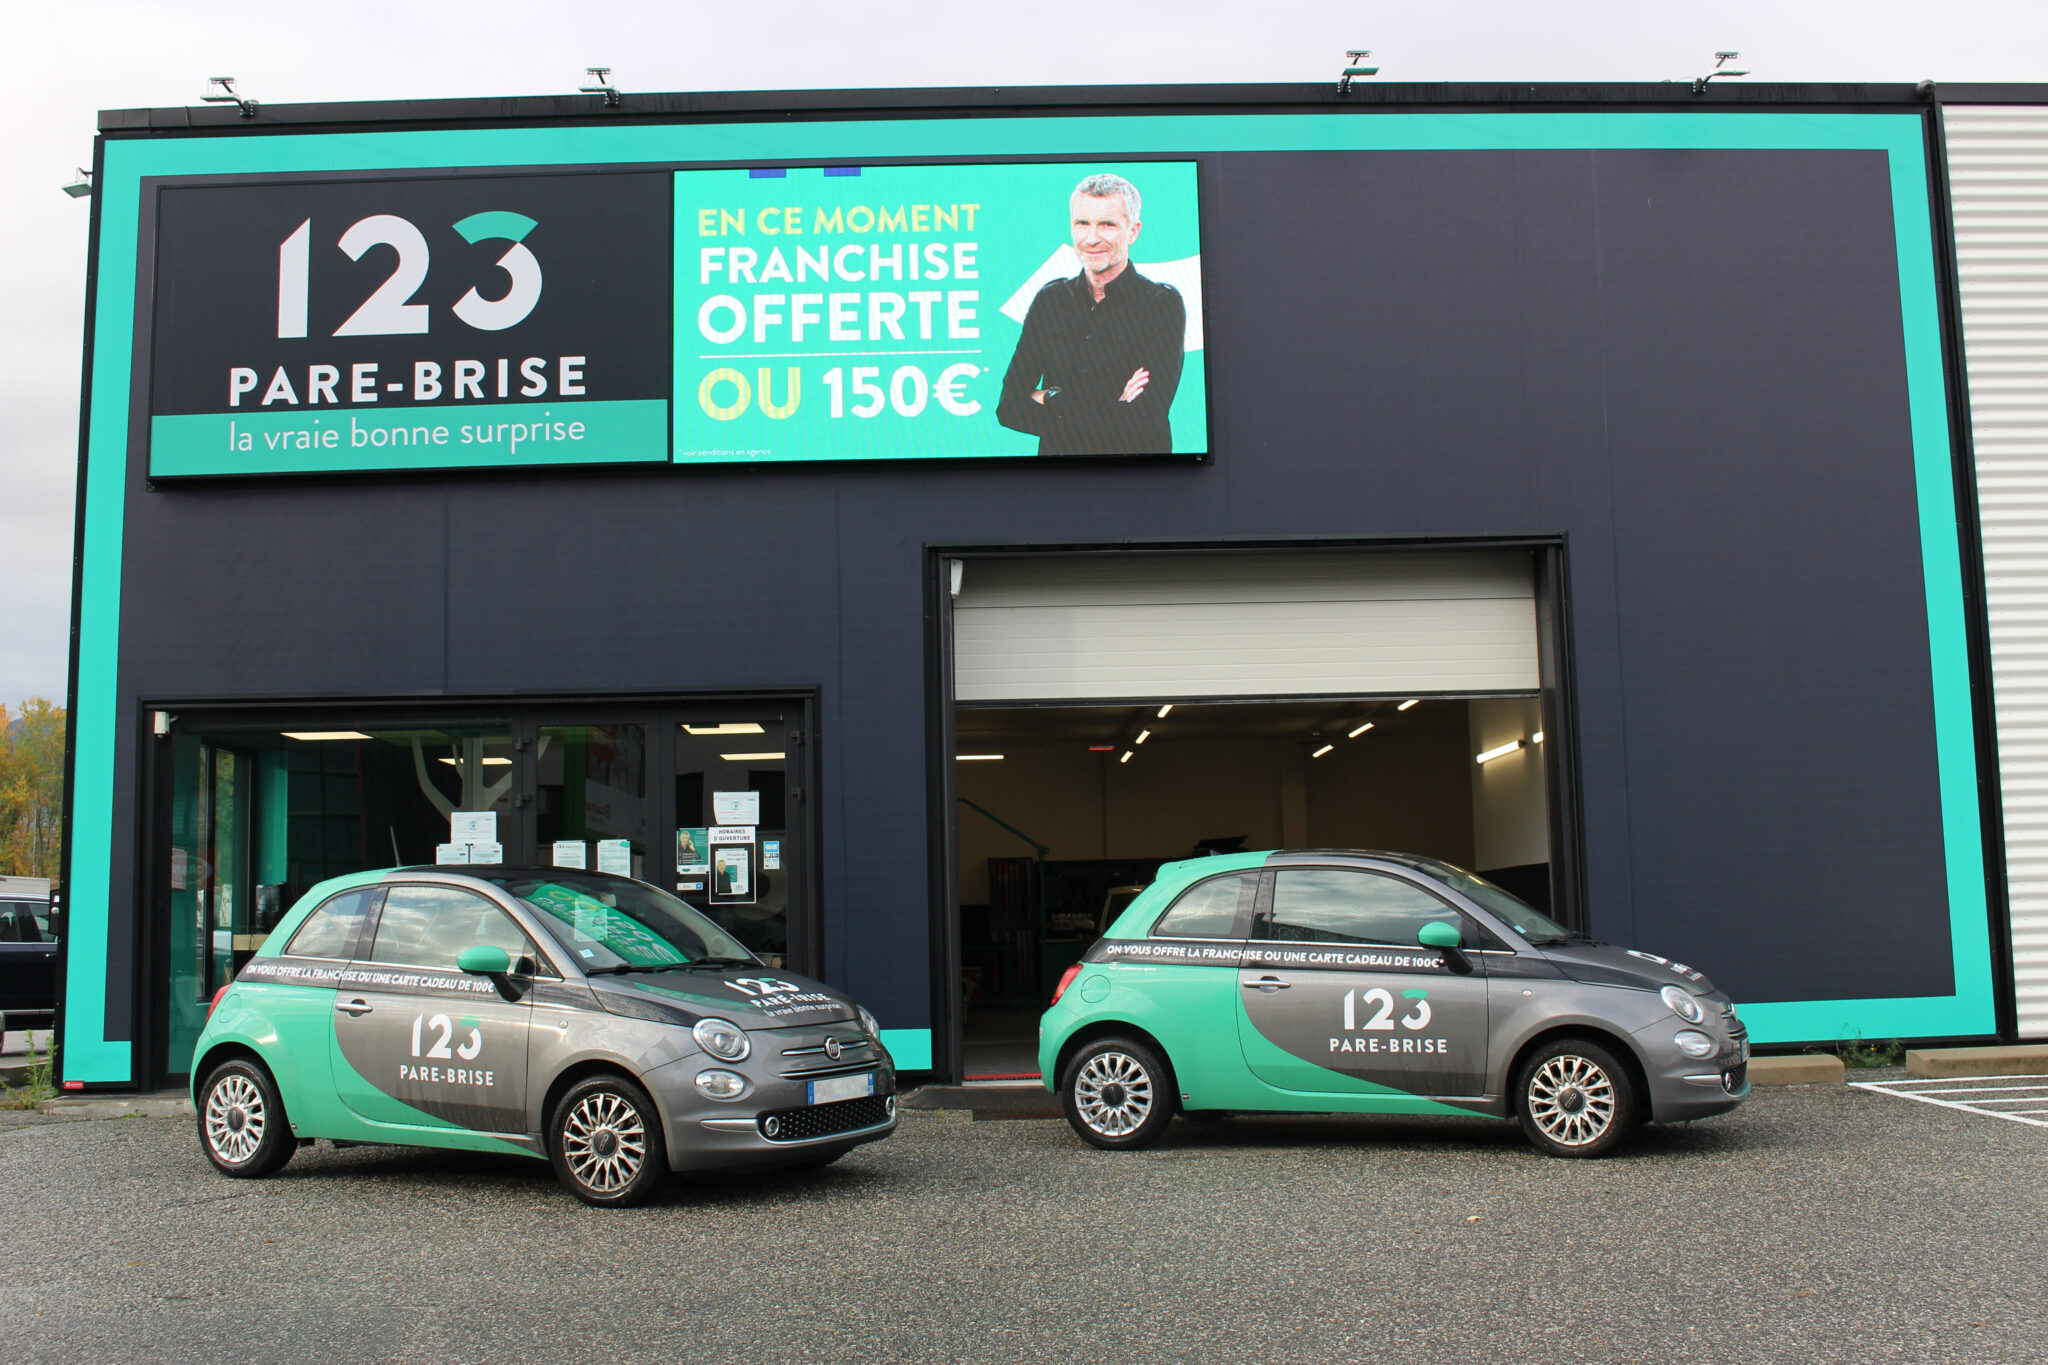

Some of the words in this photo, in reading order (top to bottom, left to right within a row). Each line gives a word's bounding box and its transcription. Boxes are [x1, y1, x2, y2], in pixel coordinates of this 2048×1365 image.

[698, 208, 746, 237] EN
[757, 206, 803, 235] CE
[813, 203, 981, 235] MOMENT
[278, 211, 542, 339] 123
[699, 242, 979, 284] FRANCHISE
[698, 290, 980, 345] OFFERTE
[229, 355, 586, 407] PARE-BRISE
[698, 366, 801, 421] OU
[230, 420, 254, 452] la
[264, 417, 339, 451] vraie
[351, 417, 450, 449] bonne
[460, 411, 586, 455] surprise
[246, 964, 256, 974] ON
[257, 965, 277, 975] VOUS
[276, 966, 300, 977] OFFRE
[301, 967, 312, 978] LA
[312, 968, 358, 981] FRANCHISE
[358, 972, 372, 982] OU
[372, 972, 391, 984] UNE
[391, 974, 420, 987] CARTE
[420, 976, 457, 989] CADEAU
[458, 980, 472, 991] DE
[1106, 945, 1122, 954] ON
[1123, 945, 1151, 955] VOUS
[1152, 946, 1185, 957] OFFRE
[1187, 947, 1201, 958] LA
[1202, 948, 1264, 960] FRANCHISE
[1264, 951, 1282, 961] OU
[1283, 952, 1307, 962] UNE
[1308, 952, 1344, 964] CARTE
[1346, 954, 1392, 966] CADEAU
[1394, 956, 1410, 967] DE
[723, 977, 800, 996] 123
[1343, 987, 1432, 1031] 123
[411, 1012, 482, 1060] 123
[1328, 1037, 1448, 1053] PARE-BRISE
[400, 1064, 494, 1086] PARE-BRISE
